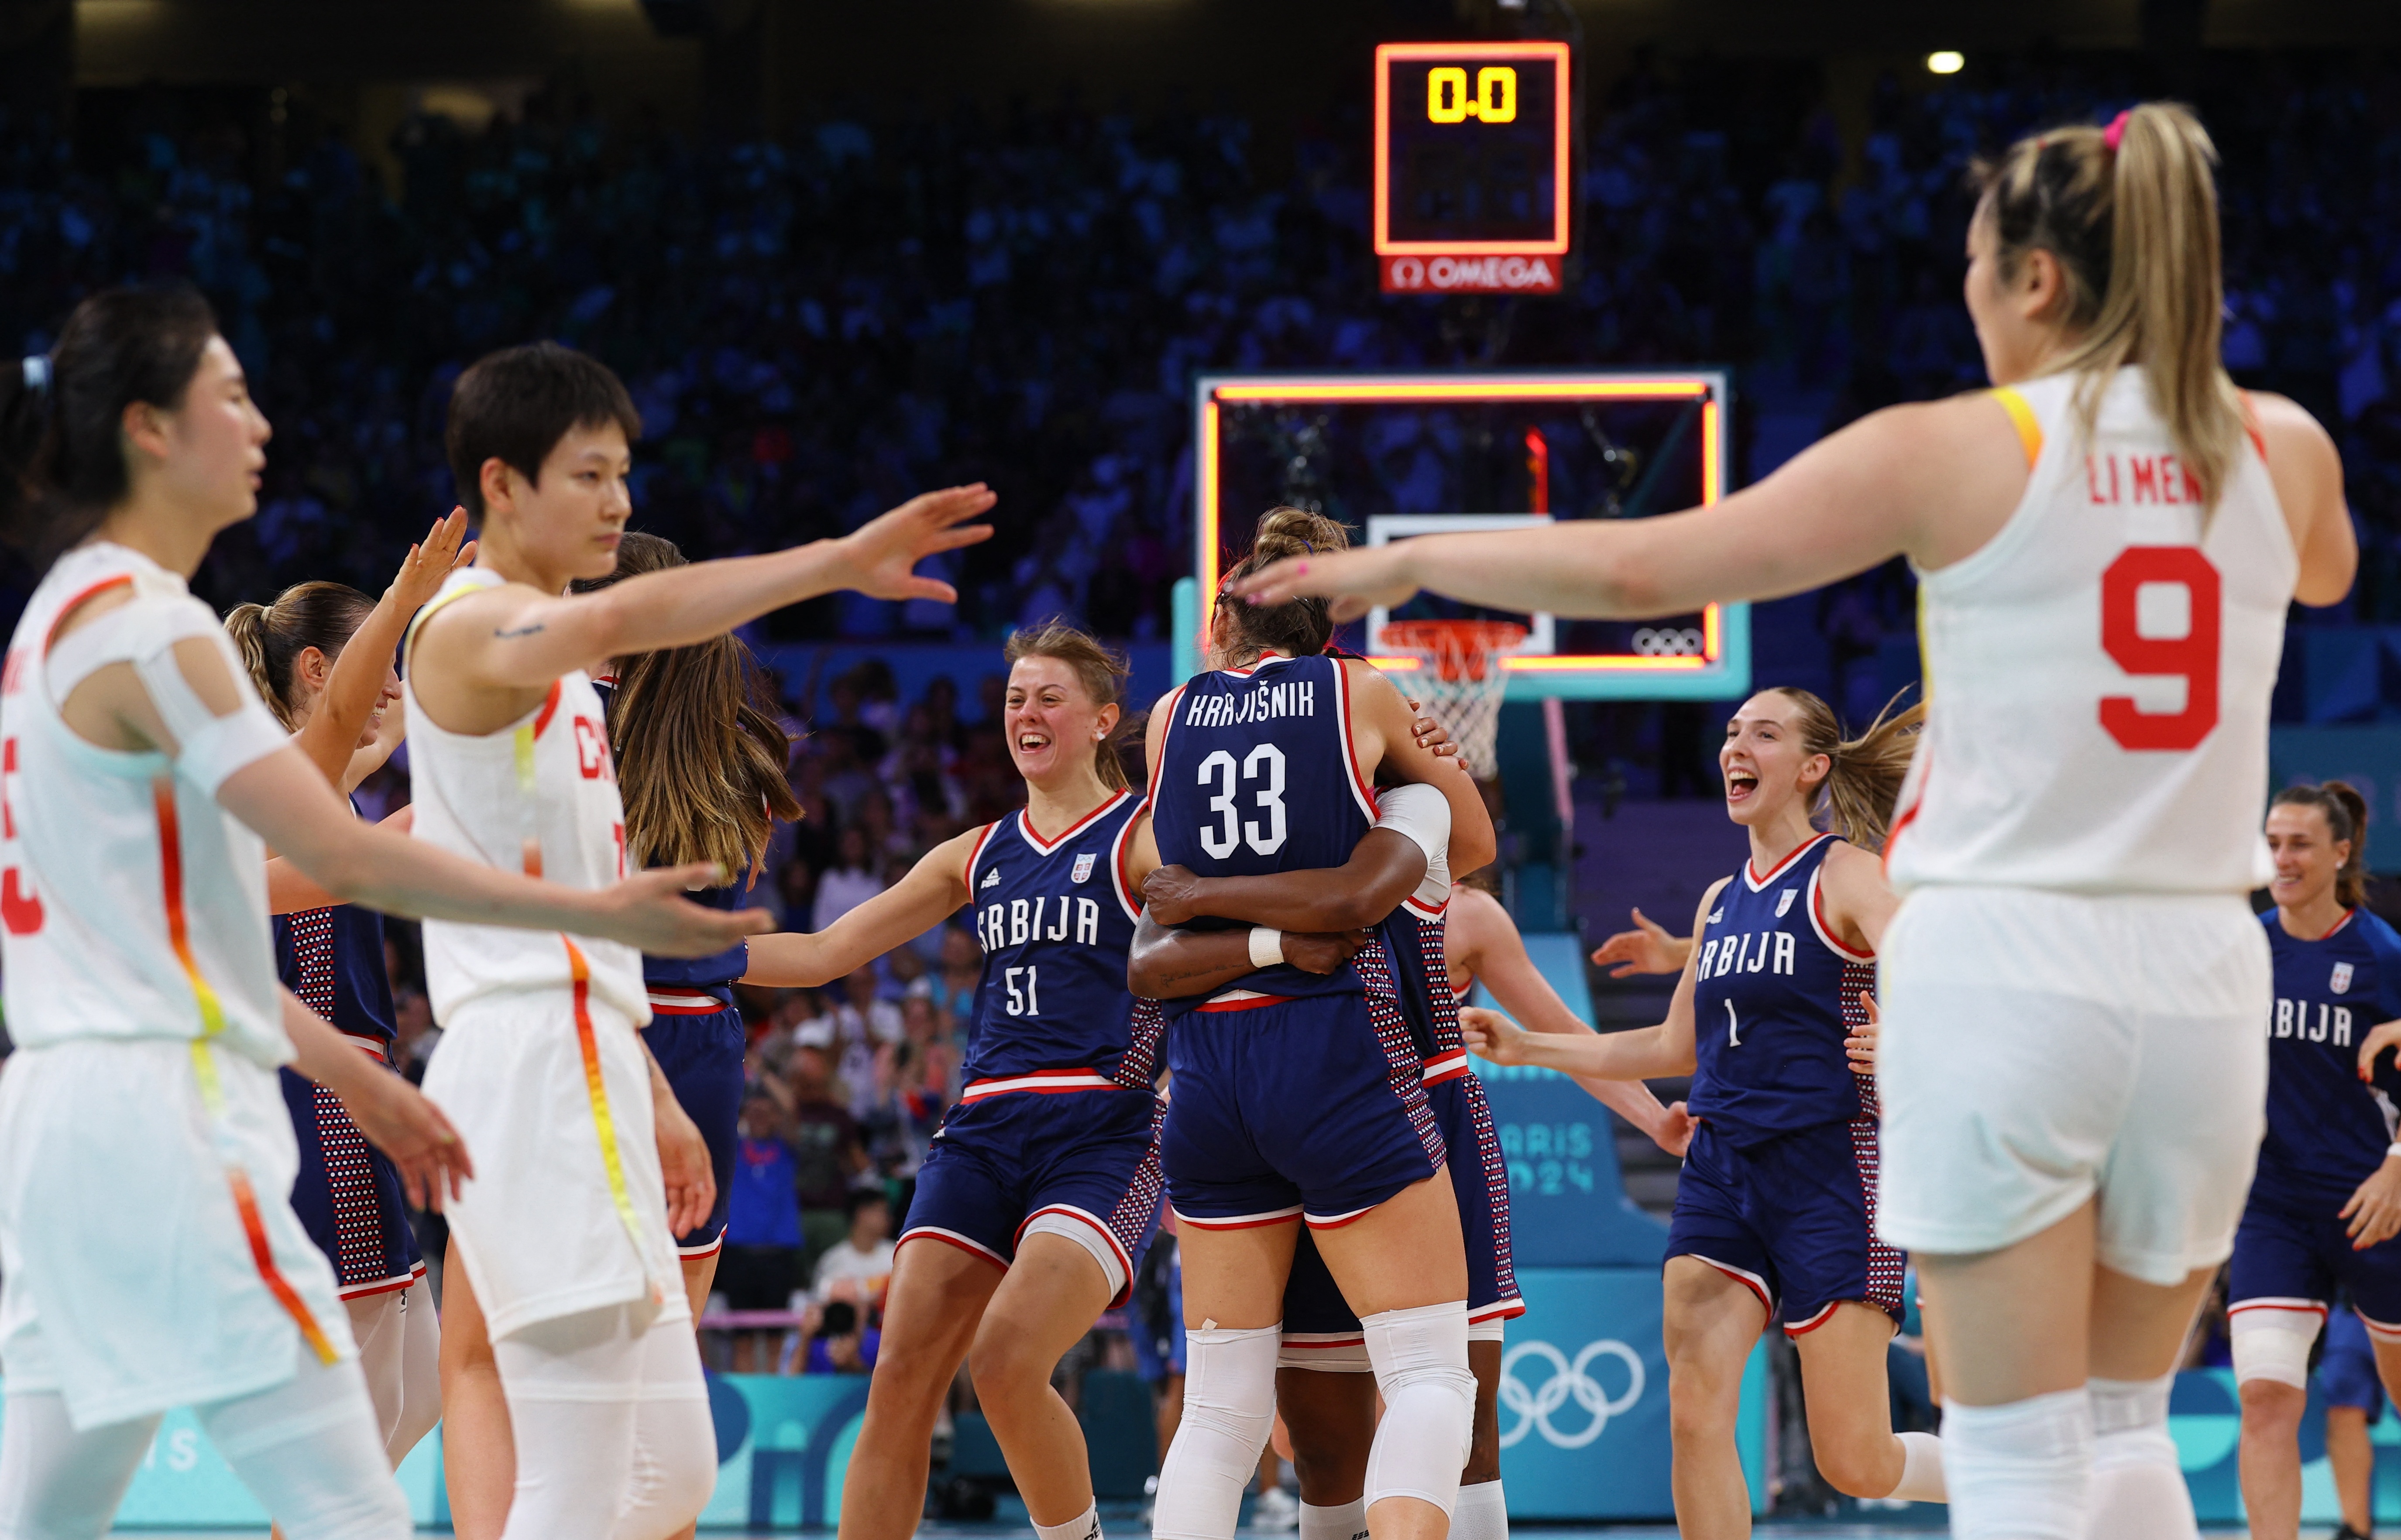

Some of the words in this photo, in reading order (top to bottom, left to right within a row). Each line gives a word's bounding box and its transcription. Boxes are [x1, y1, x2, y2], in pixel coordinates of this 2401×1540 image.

[1428, 67, 1517, 123] 0.0
[1428, 256, 1554, 288] OMEGA
[2086, 455, 2119, 504] LI
[2130, 455, 2203, 504] MEN
[2099, 545, 2222, 751] 9
[1186, 680, 1314, 727] KRAJIŠNIK
[1198, 743, 1287, 859] 33
[977, 896, 1099, 954] SRBIJA
[1005, 965, 1039, 1016] 51
[1724, 998, 1741, 1047] 1
[2267, 998, 2352, 1047] BIJA
[1499, 1123, 1592, 1158] ARIS
[1508, 1159, 1593, 1195] 024
